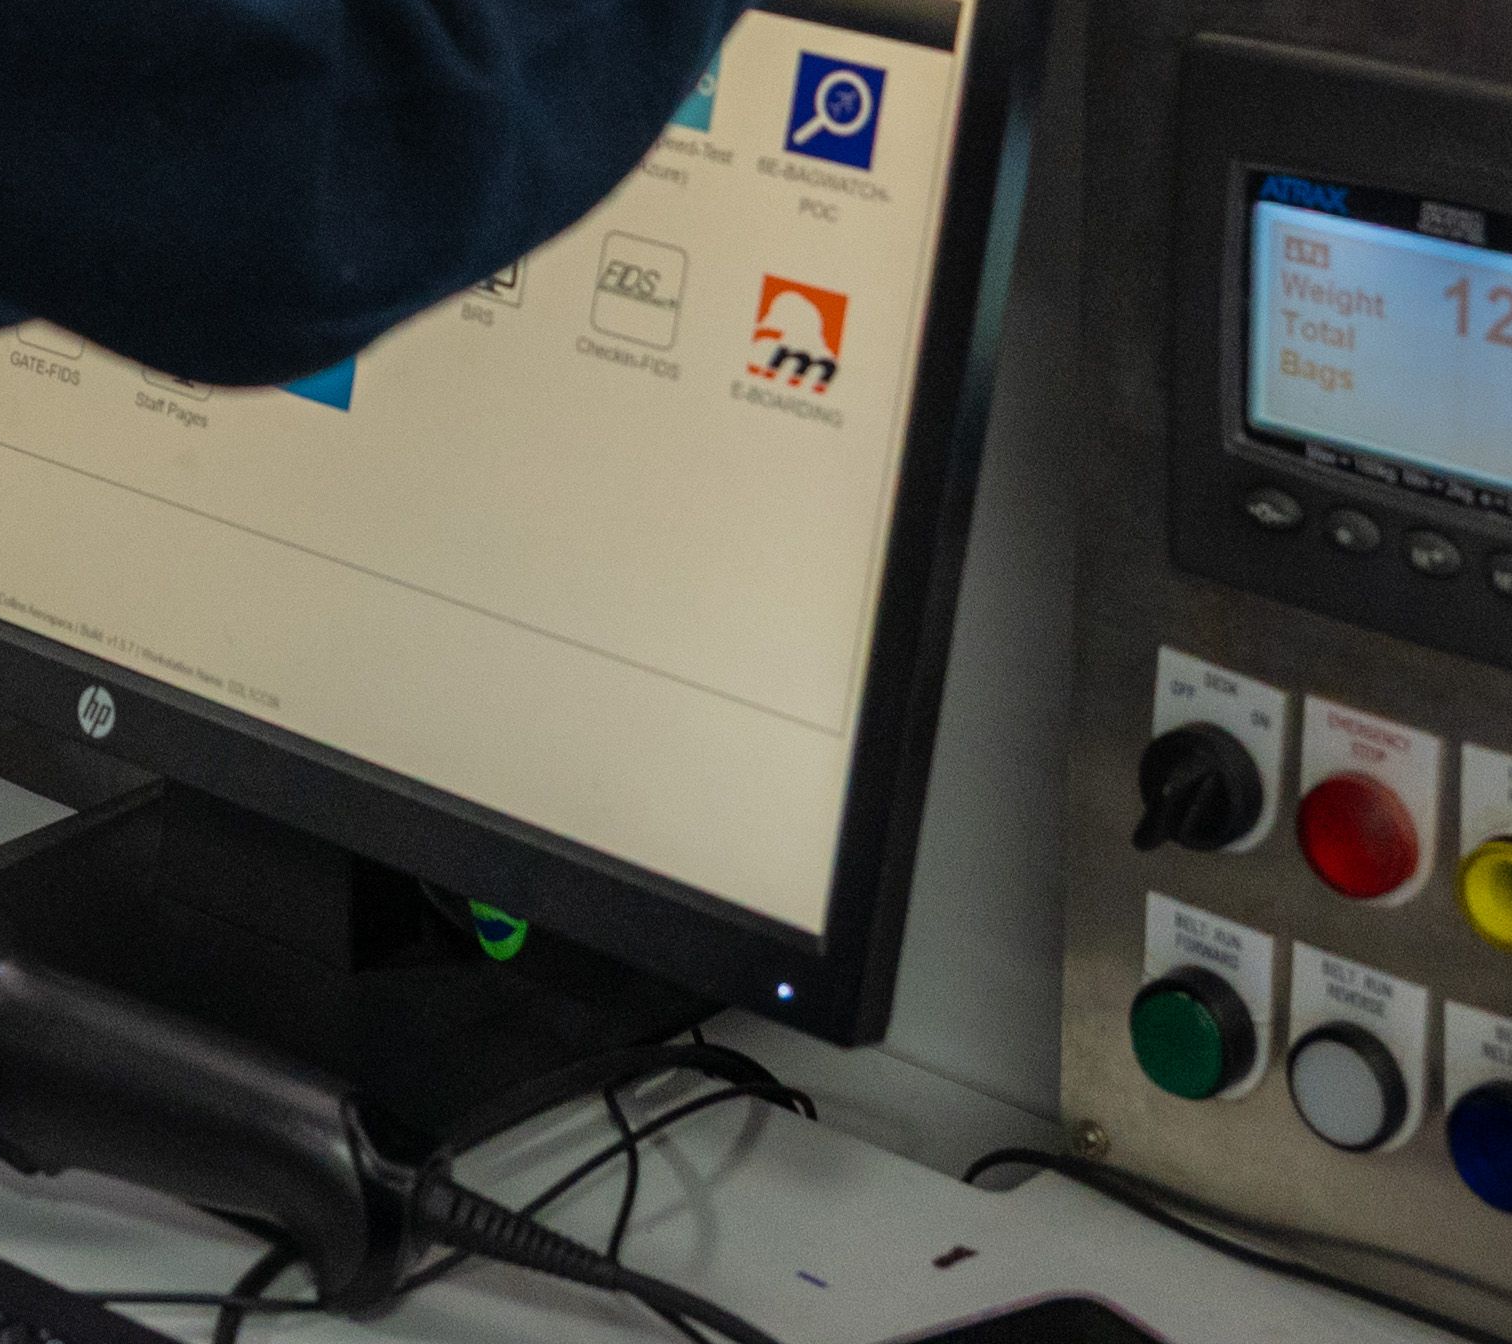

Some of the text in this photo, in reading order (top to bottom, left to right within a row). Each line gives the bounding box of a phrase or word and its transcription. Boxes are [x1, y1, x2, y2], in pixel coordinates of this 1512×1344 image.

[1260, 174, 1350, 215] ATRAX
[1279, 268, 1387, 321] Weight
[1280, 309, 1357, 353] Total
[9, 348, 82, 388] GATE-FIDS
[1278, 347, 1356, 393] Bags
[134, 388, 210, 430] Staff Pages
[80, 688, 114, 736] hp
